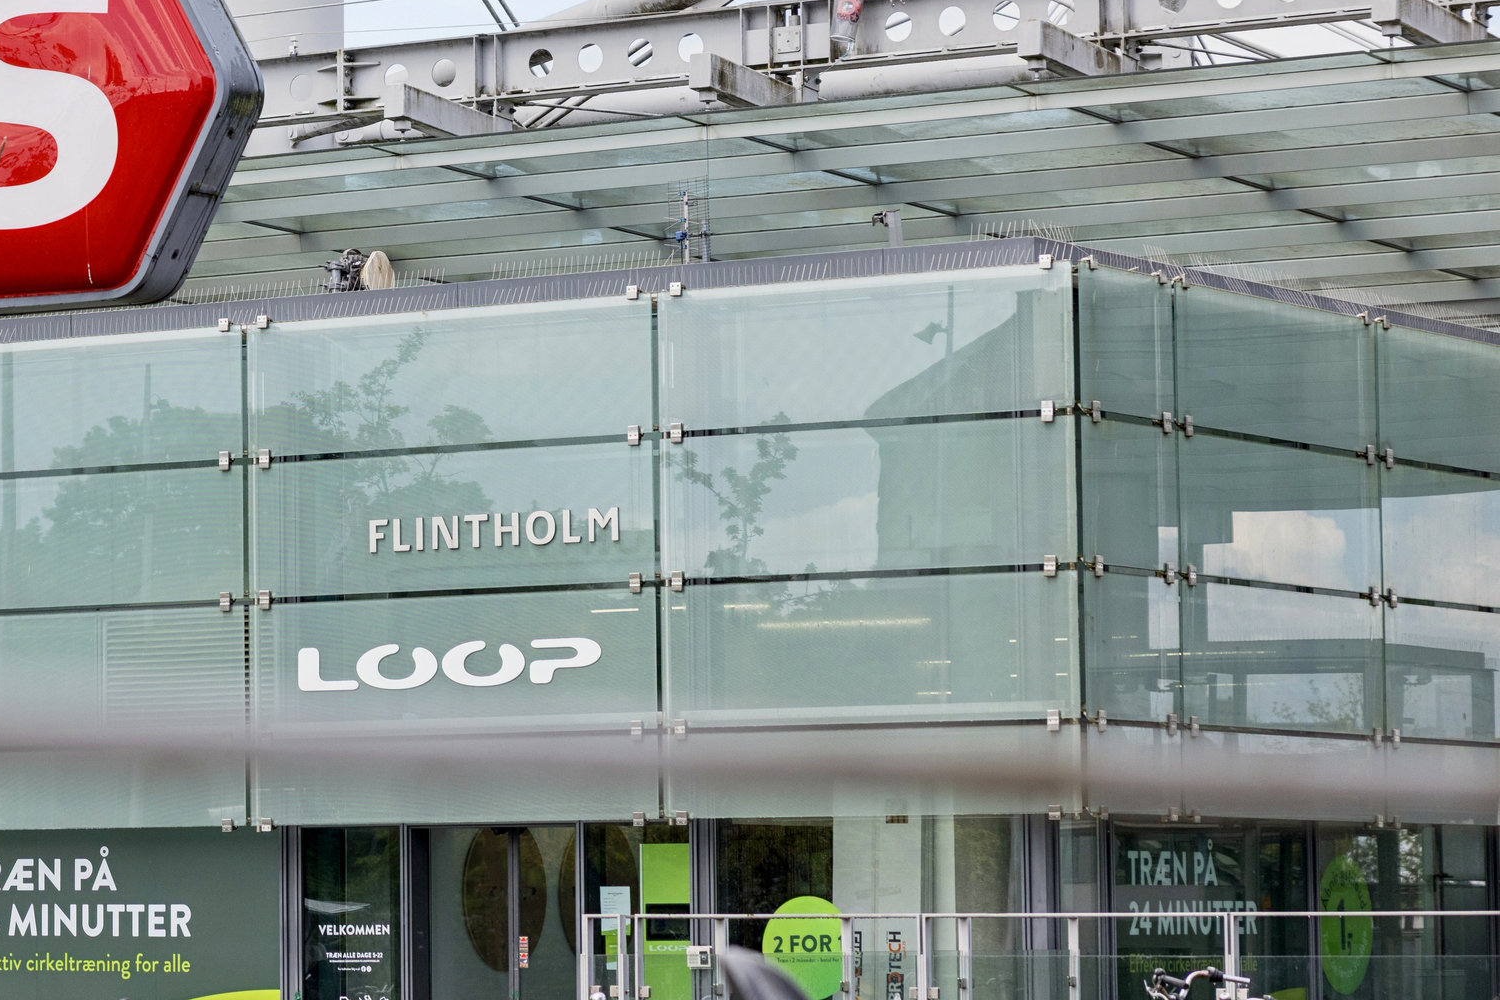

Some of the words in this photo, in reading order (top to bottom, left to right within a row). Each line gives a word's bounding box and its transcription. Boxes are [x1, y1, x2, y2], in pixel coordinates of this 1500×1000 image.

[368, 506, 621, 554] FLINTHOLM
[297, 637, 602, 692] LOOP
[74, 845, 118, 892] PÅ
[1127, 850, 1188, 887] TRÆN
[1193, 838, 1219, 887] PÅ
[8, 903, 193, 938] MINUTTER
[318, 924, 391, 936] VELKOMMEN
[1128, 900, 1153, 936] 24
[343, 951, 356, 959] ALLE
[356, 951, 372, 959] DAGE
[773, 935, 784, 953] 2
[789, 934, 832, 953] FOR
[26, 951, 131, 980] cirkeltræning
[135, 953, 160, 973] for
[163, 953, 192, 973] alle
[1167, 953, 1223, 973] cirkeltrænin
